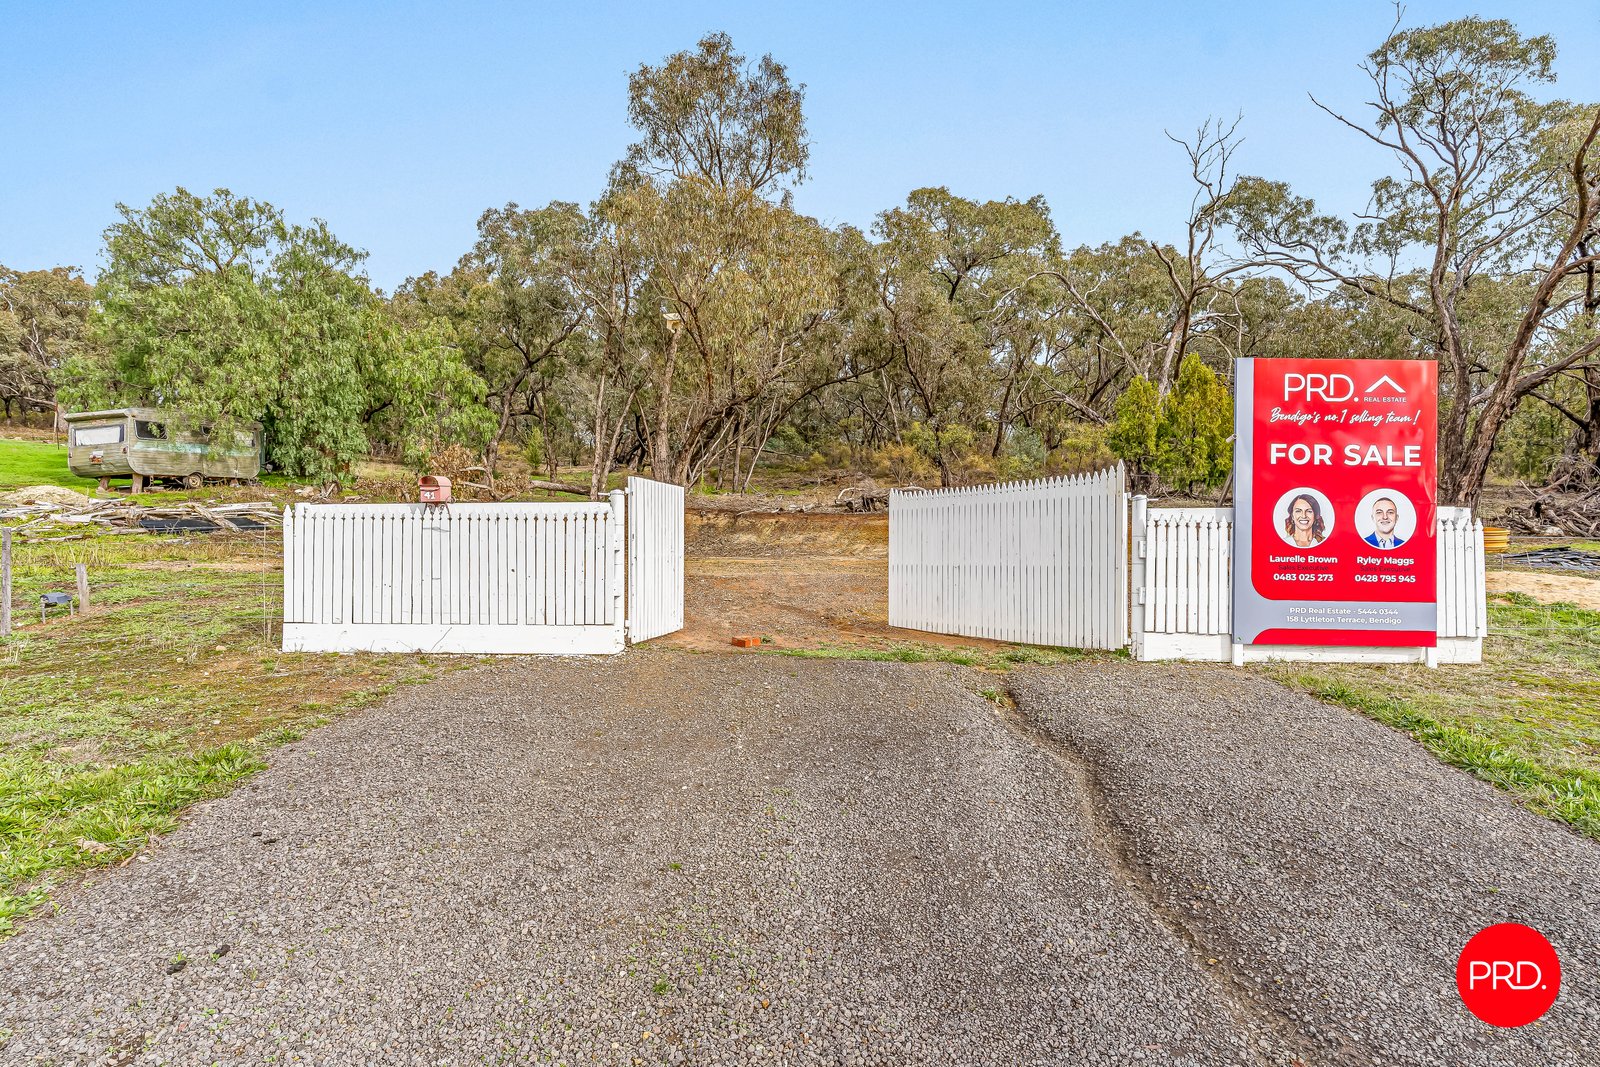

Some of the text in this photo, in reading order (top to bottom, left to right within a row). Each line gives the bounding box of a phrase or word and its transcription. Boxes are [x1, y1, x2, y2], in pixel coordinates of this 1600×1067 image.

[1284, 373, 1359, 402] PRD.
[1270, 406, 1321, 426] Bendigo's
[1350, 410, 1384, 427] selling
[1270, 444, 1422, 467] FOR SALE
[424, 491, 436, 500] 41
[1308, 556, 1338, 564] Brown
[1356, 556, 1414, 566] Ryley Maggs
[1298, 574, 1316, 582] 025
[1354, 574, 1416, 583] 0428 795 945
[1300, 616, 1336, 624] Lyttleton
[1370, 617, 1402, 626] Bendigo
